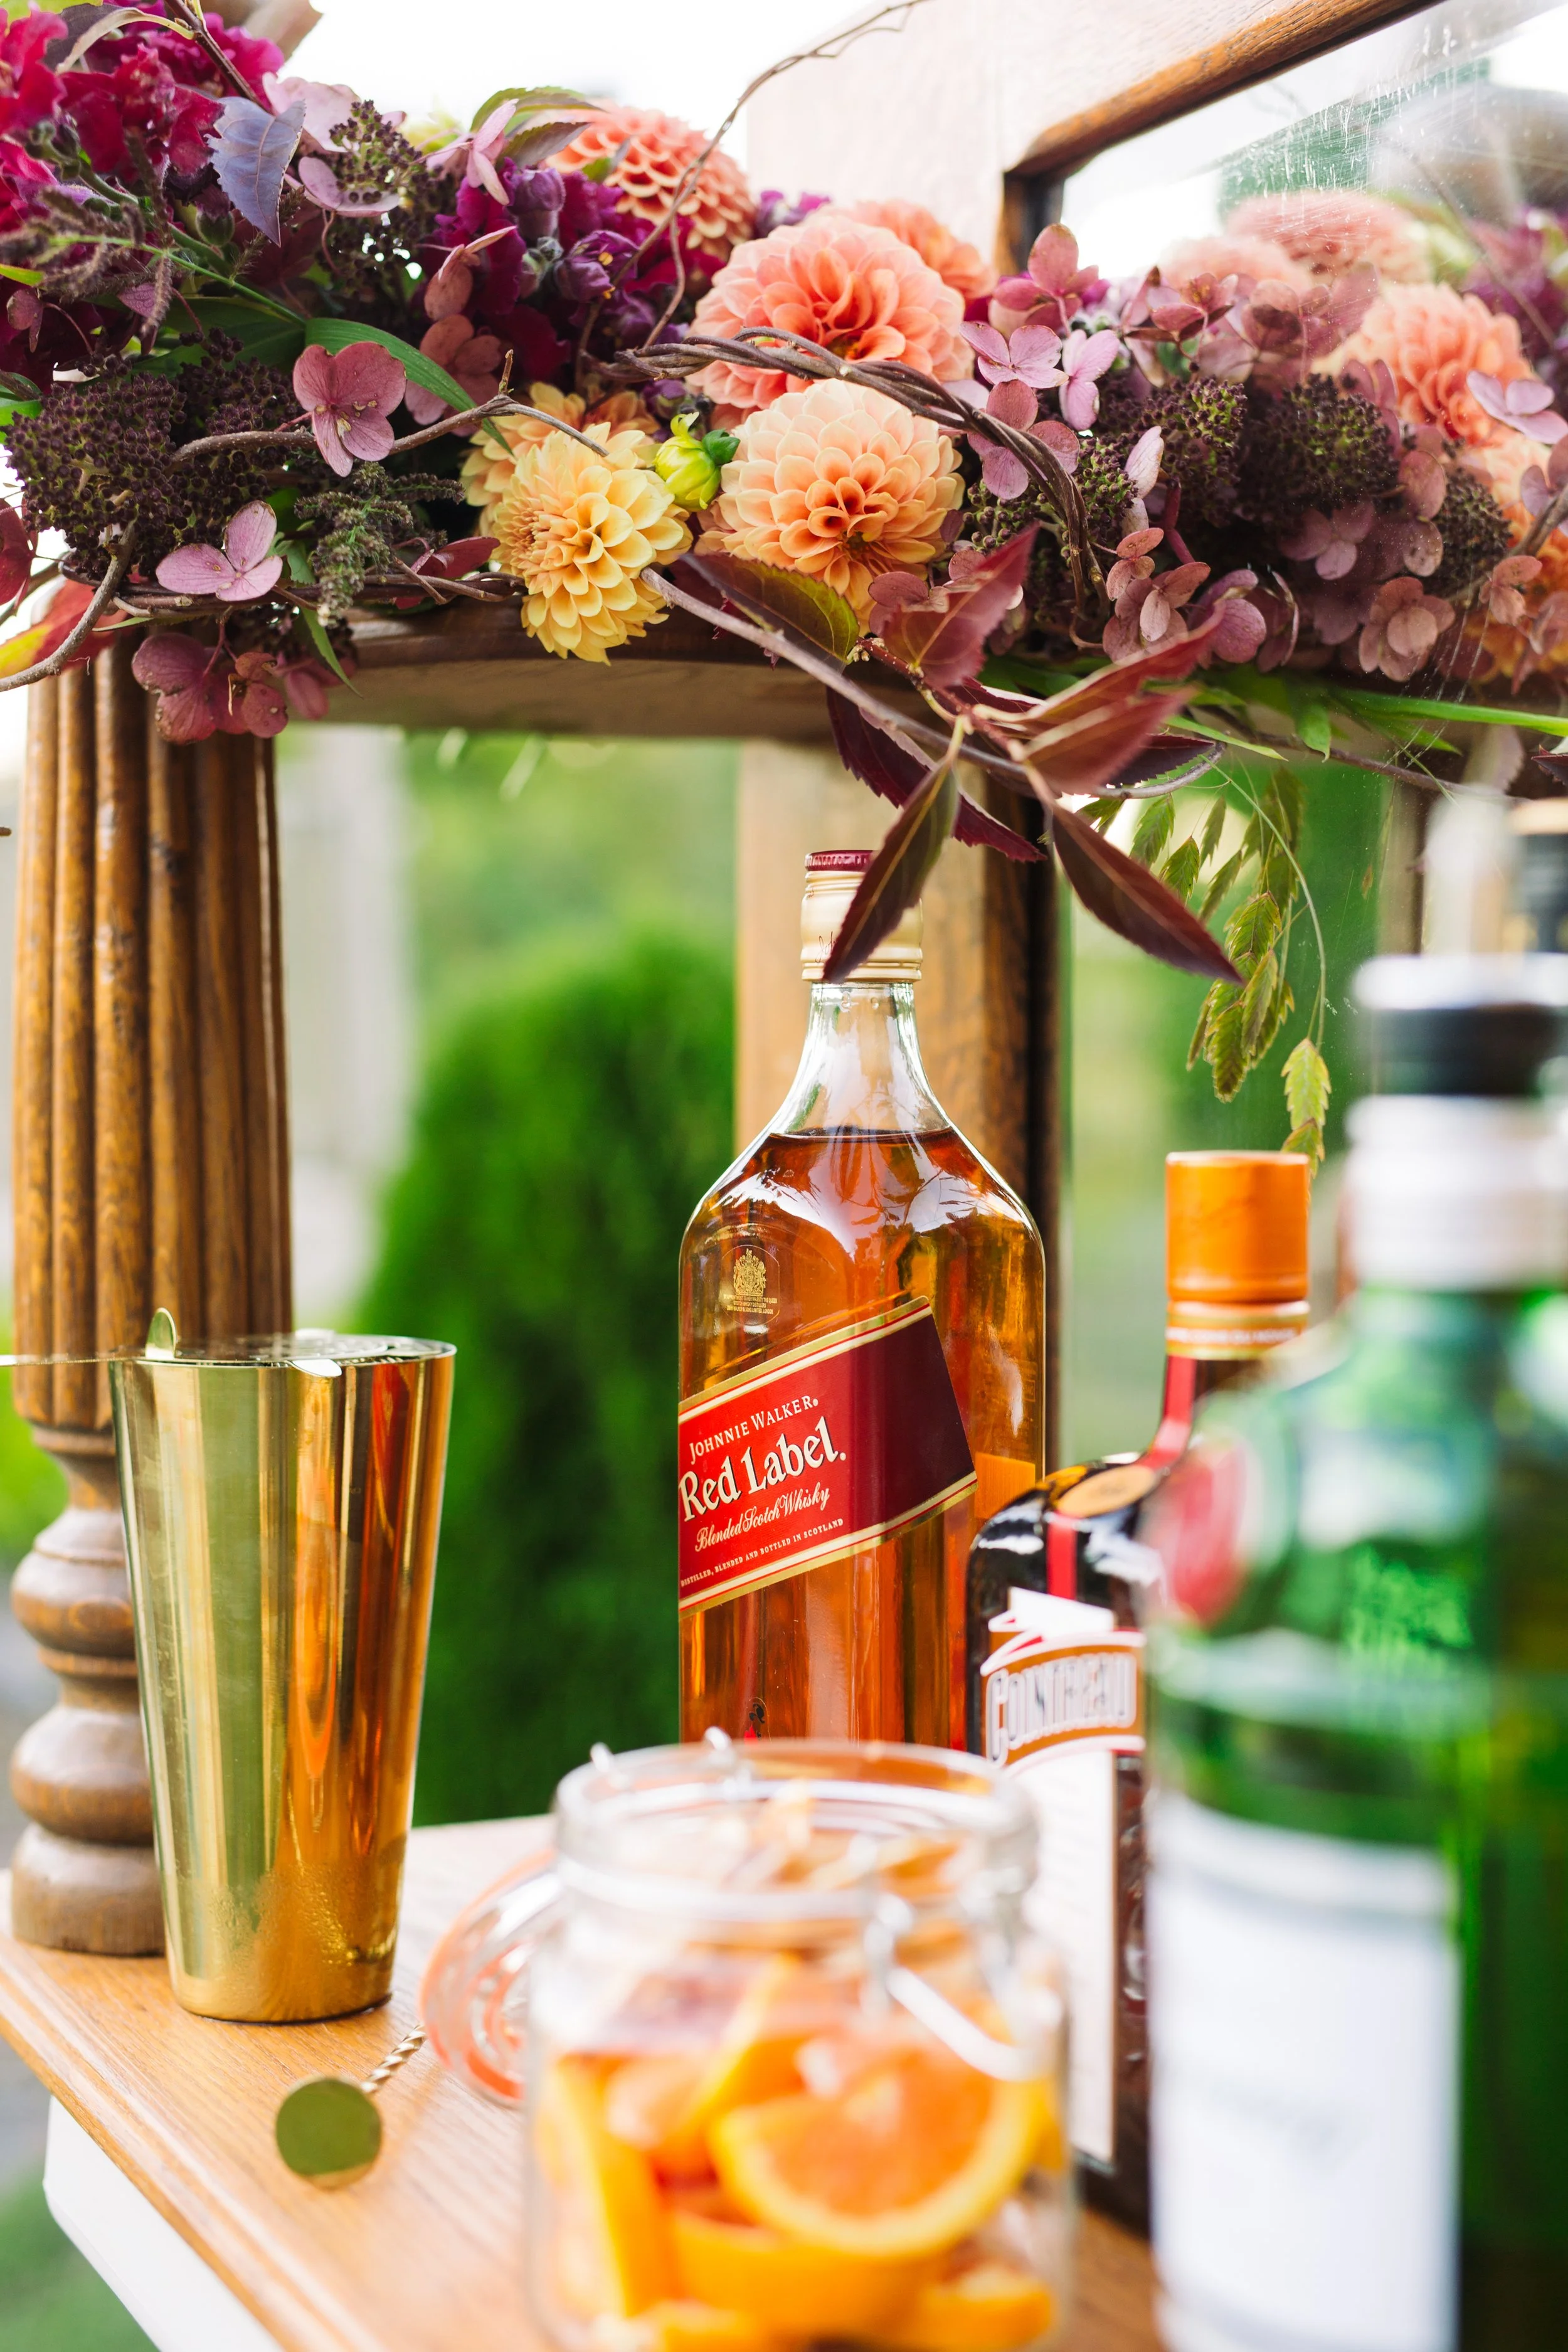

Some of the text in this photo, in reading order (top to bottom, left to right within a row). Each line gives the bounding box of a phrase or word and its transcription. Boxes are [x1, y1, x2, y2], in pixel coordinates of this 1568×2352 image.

[679, 1416, 847, 1522] Red Label.
[689, 1421, 750, 1465] JOHNNIE
[695, 1481, 830, 1552] Blended Scotch Whisky
[681, 1518, 844, 1587] DISTILLED, BLENDED AND BOTTLED IN SCOTLAND
